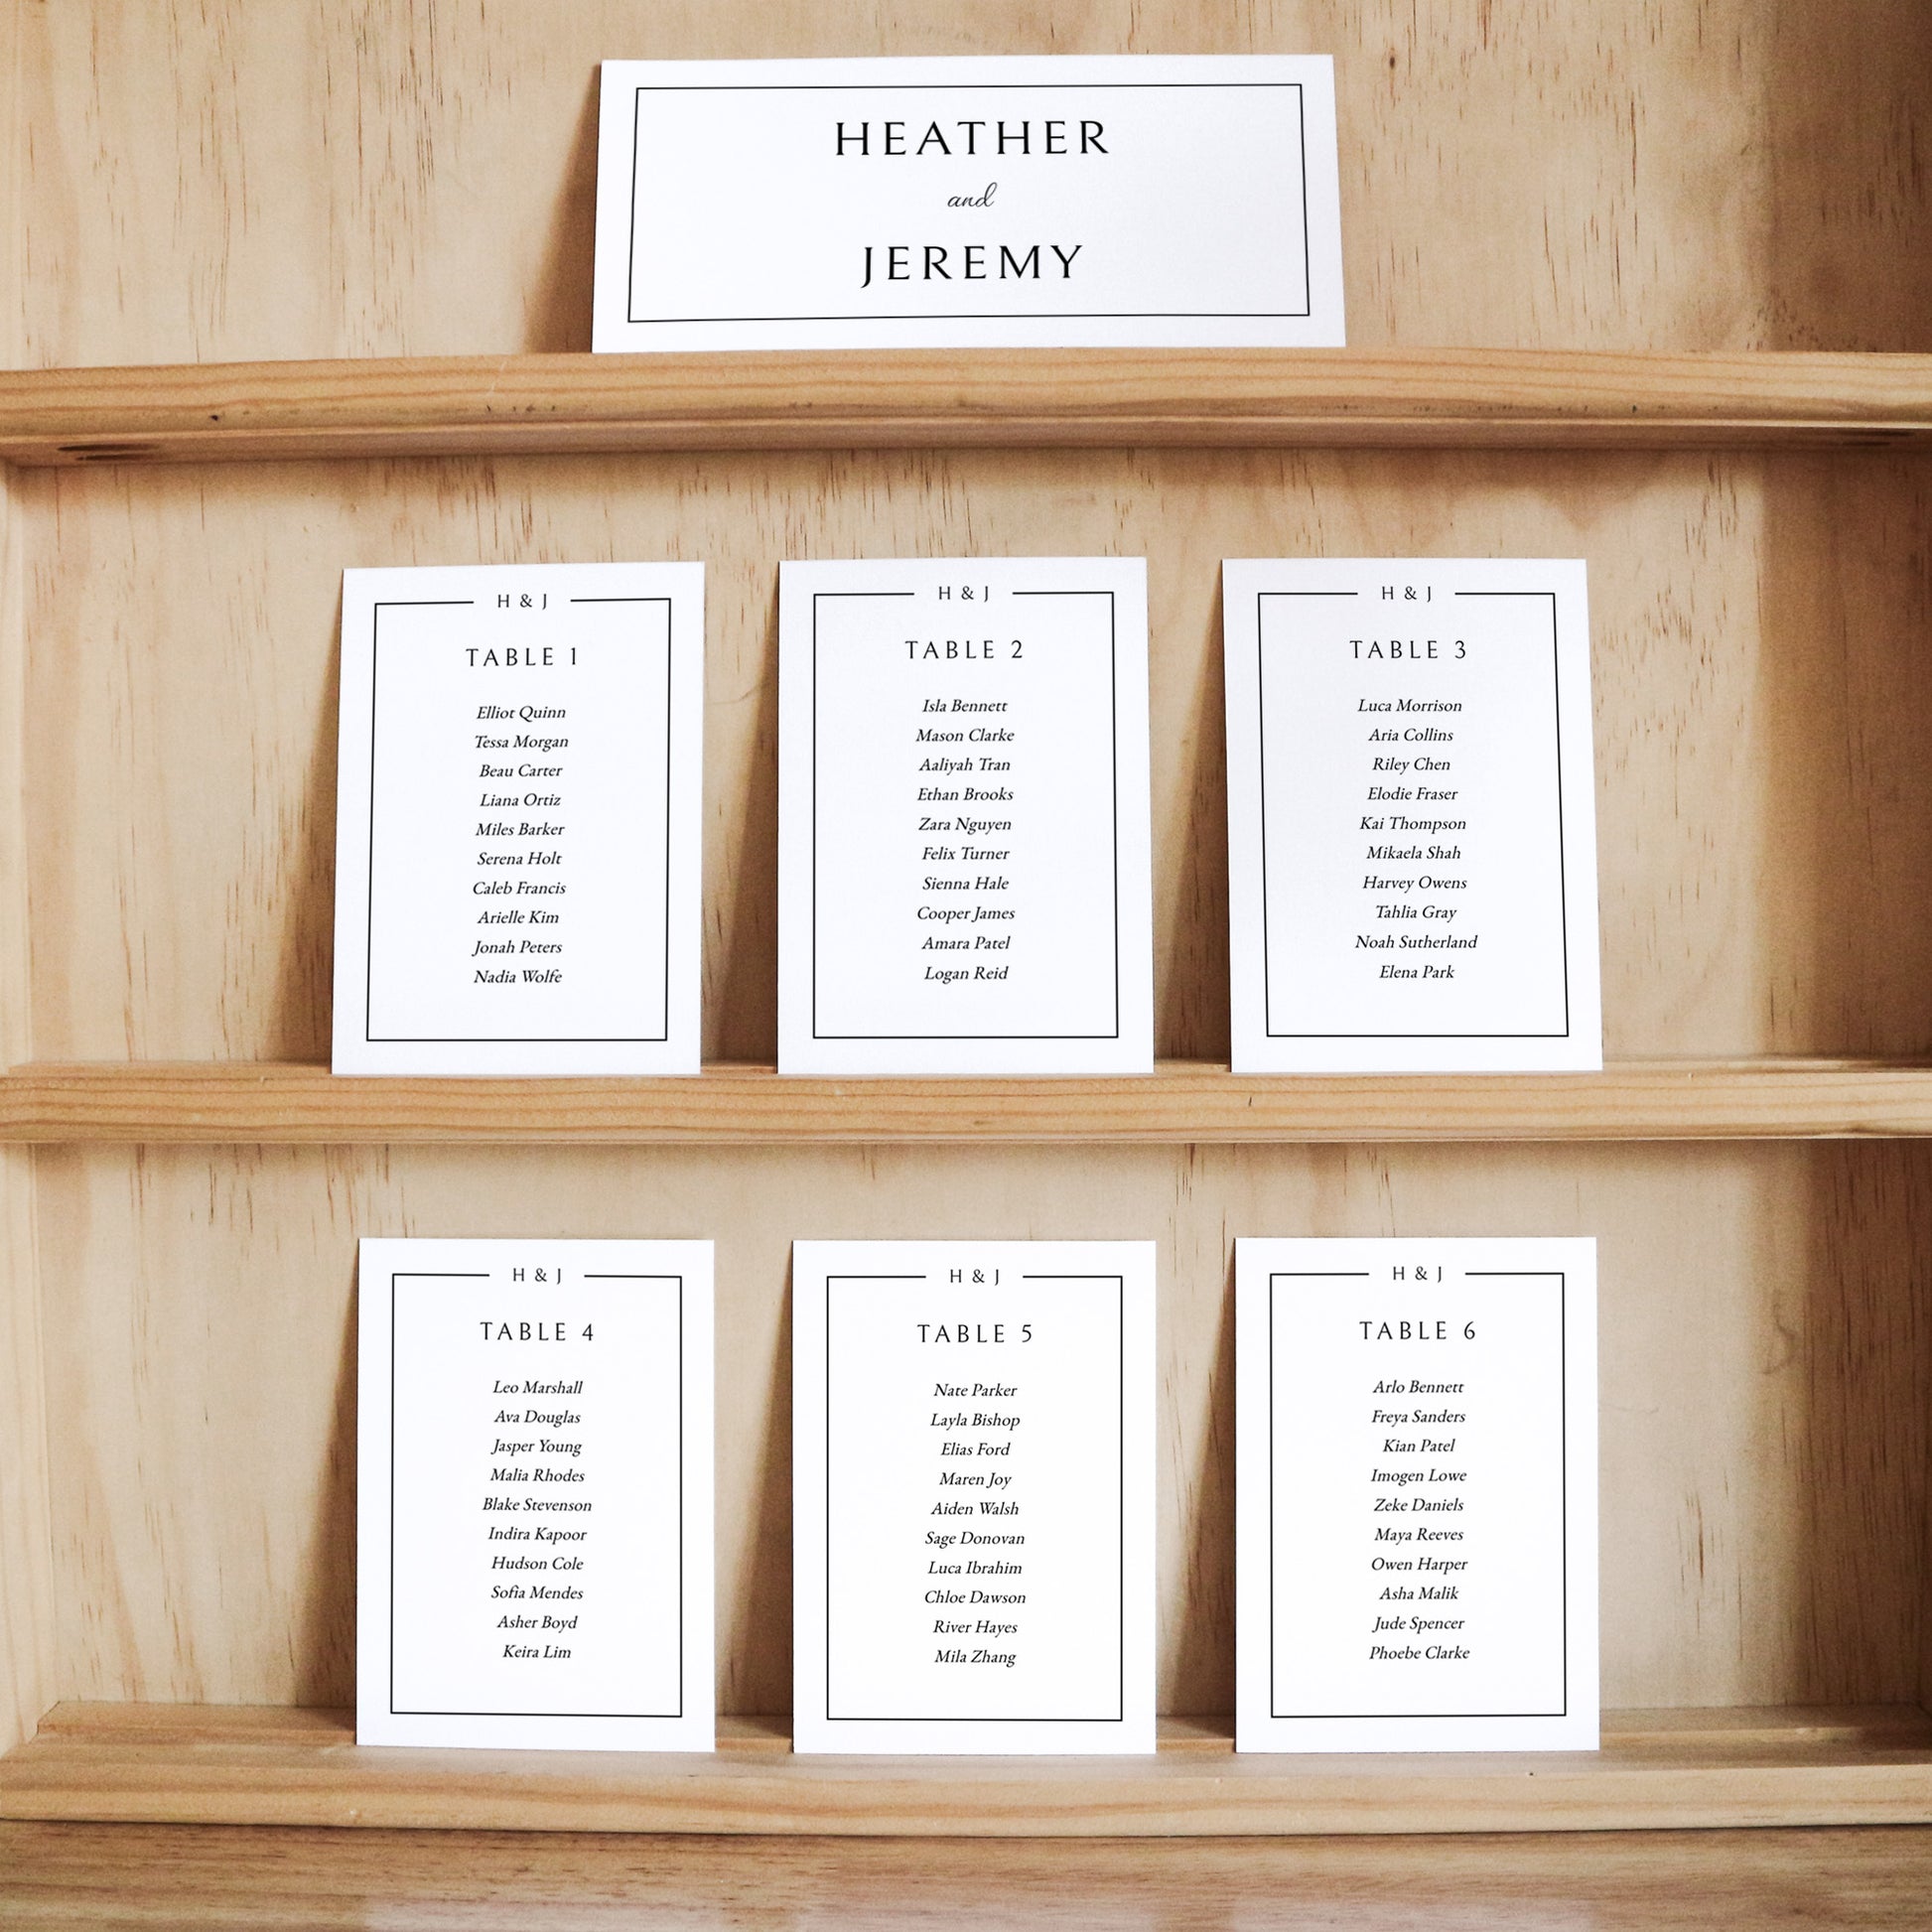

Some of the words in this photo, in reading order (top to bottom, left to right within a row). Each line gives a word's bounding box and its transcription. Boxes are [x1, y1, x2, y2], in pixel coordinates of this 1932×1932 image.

[836, 120, 1109, 156] HEATHER
[947, 182, 998, 207] and
[860, 244, 1083, 289] JEREMY
[497, 594, 510, 609] H
[519, 593, 533, 609] &
[542, 593, 547, 611] J
[938, 586, 951, 601] H
[960, 585, 974, 601] &
[984, 585, 989, 603] J
[1381, 586, 1394, 601] H
[1404, 586, 1418, 601] &
[1427, 586, 1432, 603] J
[465, 646, 554, 667] TABLE
[571, 646, 576, 666] 1
[904, 639, 995, 659] TABLE
[1011, 639, 1023, 659] 2
[1349, 639, 1439, 659] TABLE
[1454, 639, 1466, 659] 3
[476, 705, 516, 720] Elliot
[518, 705, 566, 723] Quinn
[922, 698, 947, 713] Isla
[950, 699, 1009, 713] Bennett
[1357, 698, 1392, 713] Luca
[1395, 698, 1462, 713] Morrison
[915, 728, 964, 743] Mason
[968, 727, 1016, 742] Clarke
[1367, 728, 1399, 742] Aria
[1403, 727, 1453, 742] Collins
[475, 735, 509, 749] Tessa
[512, 735, 569, 753] Morgan
[479, 763, 514, 777] Beau
[517, 763, 564, 777] Carter
[918, 757, 973, 776] Aaliyah
[979, 757, 1011, 771] Tran
[1372, 757, 1411, 775] Riley
[1413, 757, 1450, 771] Chen
[480, 793, 519, 807] Liana
[523, 792, 562, 807] Ortiz
[916, 786, 959, 801] Ethan
[963, 786, 1014, 801] Brooks
[1367, 785, 1413, 800] Elodie
[1416, 786, 1459, 800] Fraser
[475, 822, 515, 836] Miles
[517, 821, 566, 836] Barker
[917, 817, 951, 831] Zara
[955, 817, 1012, 836] Nguyen
[1359, 816, 1385, 830] Kai
[1389, 815, 1466, 835] Thompson
[477, 852, 523, 866] Serena
[527, 851, 563, 865] Holt
[921, 846, 956, 861] Felix
[961, 846, 1011, 861] Turner
[1366, 845, 1423, 860] Mikaela
[1426, 845, 1461, 860] Shah
[473, 881, 513, 896] Caleb
[515, 881, 567, 895] Francis
[921, 876, 970, 891] Sienna
[974, 876, 1010, 891] Hale
[1362, 876, 1415, 895] Harvey
[1418, 875, 1467, 890] Owens
[477, 909, 525, 924] Arielle
[528, 909, 560, 924] Kim
[916, 905, 972, 925] Cooper
[970, 905, 1016, 923] James
[1375, 904, 1418, 919] Tahlia
[1422, 904, 1457, 923] Gray
[471, 939, 515, 957] Jonah
[519, 939, 563, 954] Peters
[921, 936, 970, 950] Amara
[974, 935, 1012, 950] Patel
[1355, 934, 1395, 949] Noah
[1398, 934, 1478, 949] Sutherland
[474, 969, 516, 984] Nadia
[522, 968, 563, 984] Wolfe
[923, 966, 970, 985] Logan
[973, 965, 1010, 980] Reid
[1379, 964, 1418, 979] Elena
[1422, 964, 1455, 979] Park
[512, 1267, 525, 1282] H
[534, 1267, 547, 1283] &
[556, 1268, 561, 1285] J
[950, 1269, 962, 1284] H
[972, 1269, 985, 1284] &
[994, 1269, 1000, 1287] J
[1393, 1266, 1405, 1281] H
[1415, 1266, 1428, 1281] &
[1438, 1266, 1442, 1283] J
[480, 1321, 566, 1341] TABLE
[582, 1323, 594, 1341] 4
[916, 1323, 1005, 1343] TABLE
[1022, 1323, 1033, 1343] 5
[1358, 1320, 1447, 1340] TABLE
[1463, 1320, 1476, 1340] 6
[492, 1380, 519, 1394] Leo
[522, 1380, 584, 1395] Marshall
[933, 1383, 969, 1397] Nate
[971, 1382, 1019, 1397] Parker
[1372, 1379, 1406, 1394] Arlo
[1409, 1379, 1464, 1394] Bennett
[493, 1410, 520, 1423] Ava
[523, 1410, 581, 1429] Douglas
[929, 1412, 968, 1432] Layla
[971, 1412, 1021, 1432] Bishop
[1371, 1409, 1409, 1428] Freya
[1411, 1409, 1466, 1423] Sanders
[489, 1439, 535, 1457] Jasper
[539, 1439, 583, 1457] Young
[940, 1442, 974, 1456] Elias
[977, 1442, 1012, 1456] Ford
[1383, 1439, 1416, 1452] Kian
[1420, 1438, 1456, 1452] Patel
[489, 1467, 529, 1482] Malia
[532, 1467, 586, 1482] Rhodes
[938, 1471, 985, 1486] Maren
[985, 1471, 1013, 1490] Joy
[1370, 1468, 1425, 1487] Imogen
[1428, 1468, 1467, 1482] Lowe
[483, 1496, 520, 1511] Blake
[522, 1497, 593, 1512] Stevenson
[930, 1501, 974, 1516] Aiden
[979, 1501, 1020, 1516] Walsh
[1373, 1497, 1409, 1512] Zeke
[1411, 1497, 1464, 1512] Daniels
[487, 1526, 530, 1541] Indira
[534, 1527, 588, 1546] Kapoor
[924, 1531, 957, 1550] Sage
[959, 1531, 1026, 1545] Donovan
[1374, 1527, 1413, 1546] Maya
[1416, 1527, 1464, 1541] Reeves
[491, 1556, 548, 1570] Hudson
[552, 1556, 585, 1571] Cole
[927, 1561, 962, 1575] Luca
[965, 1560, 1023, 1575] Ibrahim
[1371, 1557, 1413, 1571] Owen
[1417, 1557, 1468, 1576] Harper
[490, 1585, 526, 1599] Sofia
[529, 1586, 584, 1599] Mendes
[924, 1589, 966, 1604] Chloe
[969, 1589, 1027, 1604] Dawson
[1379, 1586, 1415, 1600] Asha
[1418, 1586, 1459, 1600] Malik
[496, 1614, 539, 1629] Asher
[541, 1614, 579, 1634] Boyd
[932, 1619, 973, 1634] River
[975, 1619, 1019, 1638] Hayes
[1371, 1615, 1407, 1633] Jude
[1409, 1615, 1465, 1635] Spencer
[502, 1644, 539, 1658] Keira
[543, 1645, 572, 1659] Lim
[934, 1649, 967, 1663] Mila
[970, 1649, 1017, 1668] Zhang
[1369, 1645, 1422, 1660] Phoebe
[1425, 1645, 1470, 1660] Clarke
